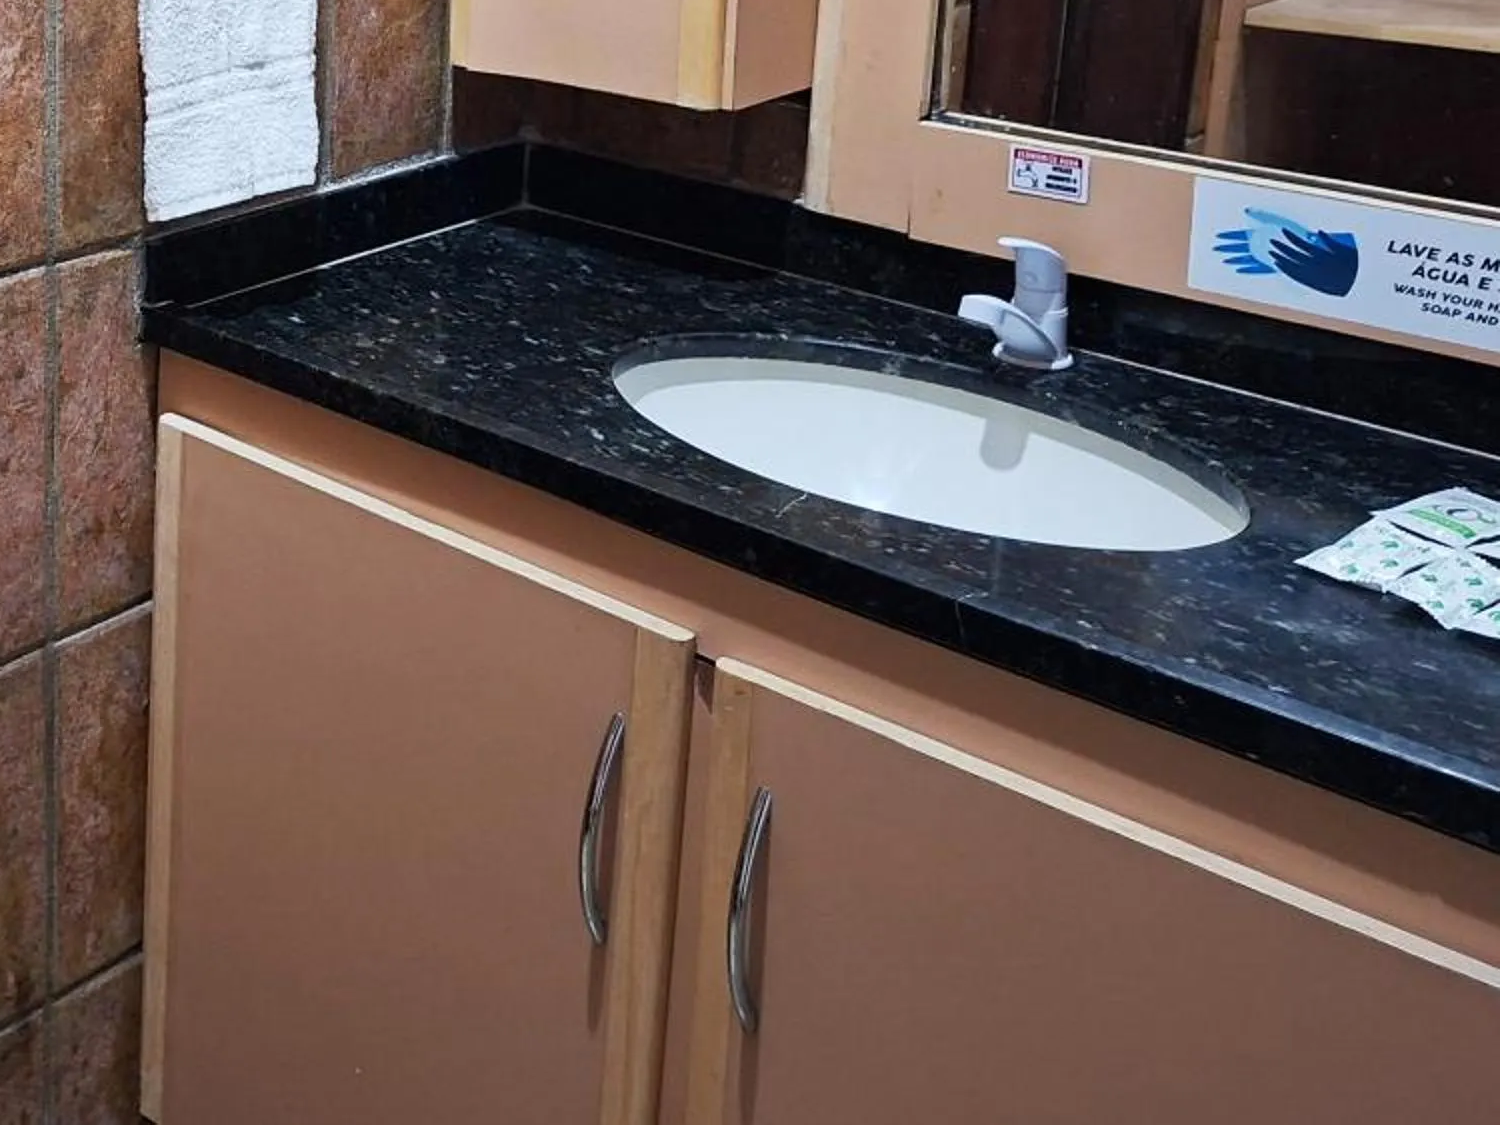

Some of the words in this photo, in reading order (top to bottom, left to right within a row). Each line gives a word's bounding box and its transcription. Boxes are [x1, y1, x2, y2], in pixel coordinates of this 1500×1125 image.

[1387, 240, 1441, 262] LAVE
[1445, 252, 1475, 267] AS
[1412, 261, 1469, 287] ÁGUA
[1478, 277, 1493, 290] E
[1394, 282, 1437, 300] WASH
[1442, 292, 1484, 310] YOUR
[1421, 302, 1462, 317] SOAP
[1464, 312, 1499, 326] AND
